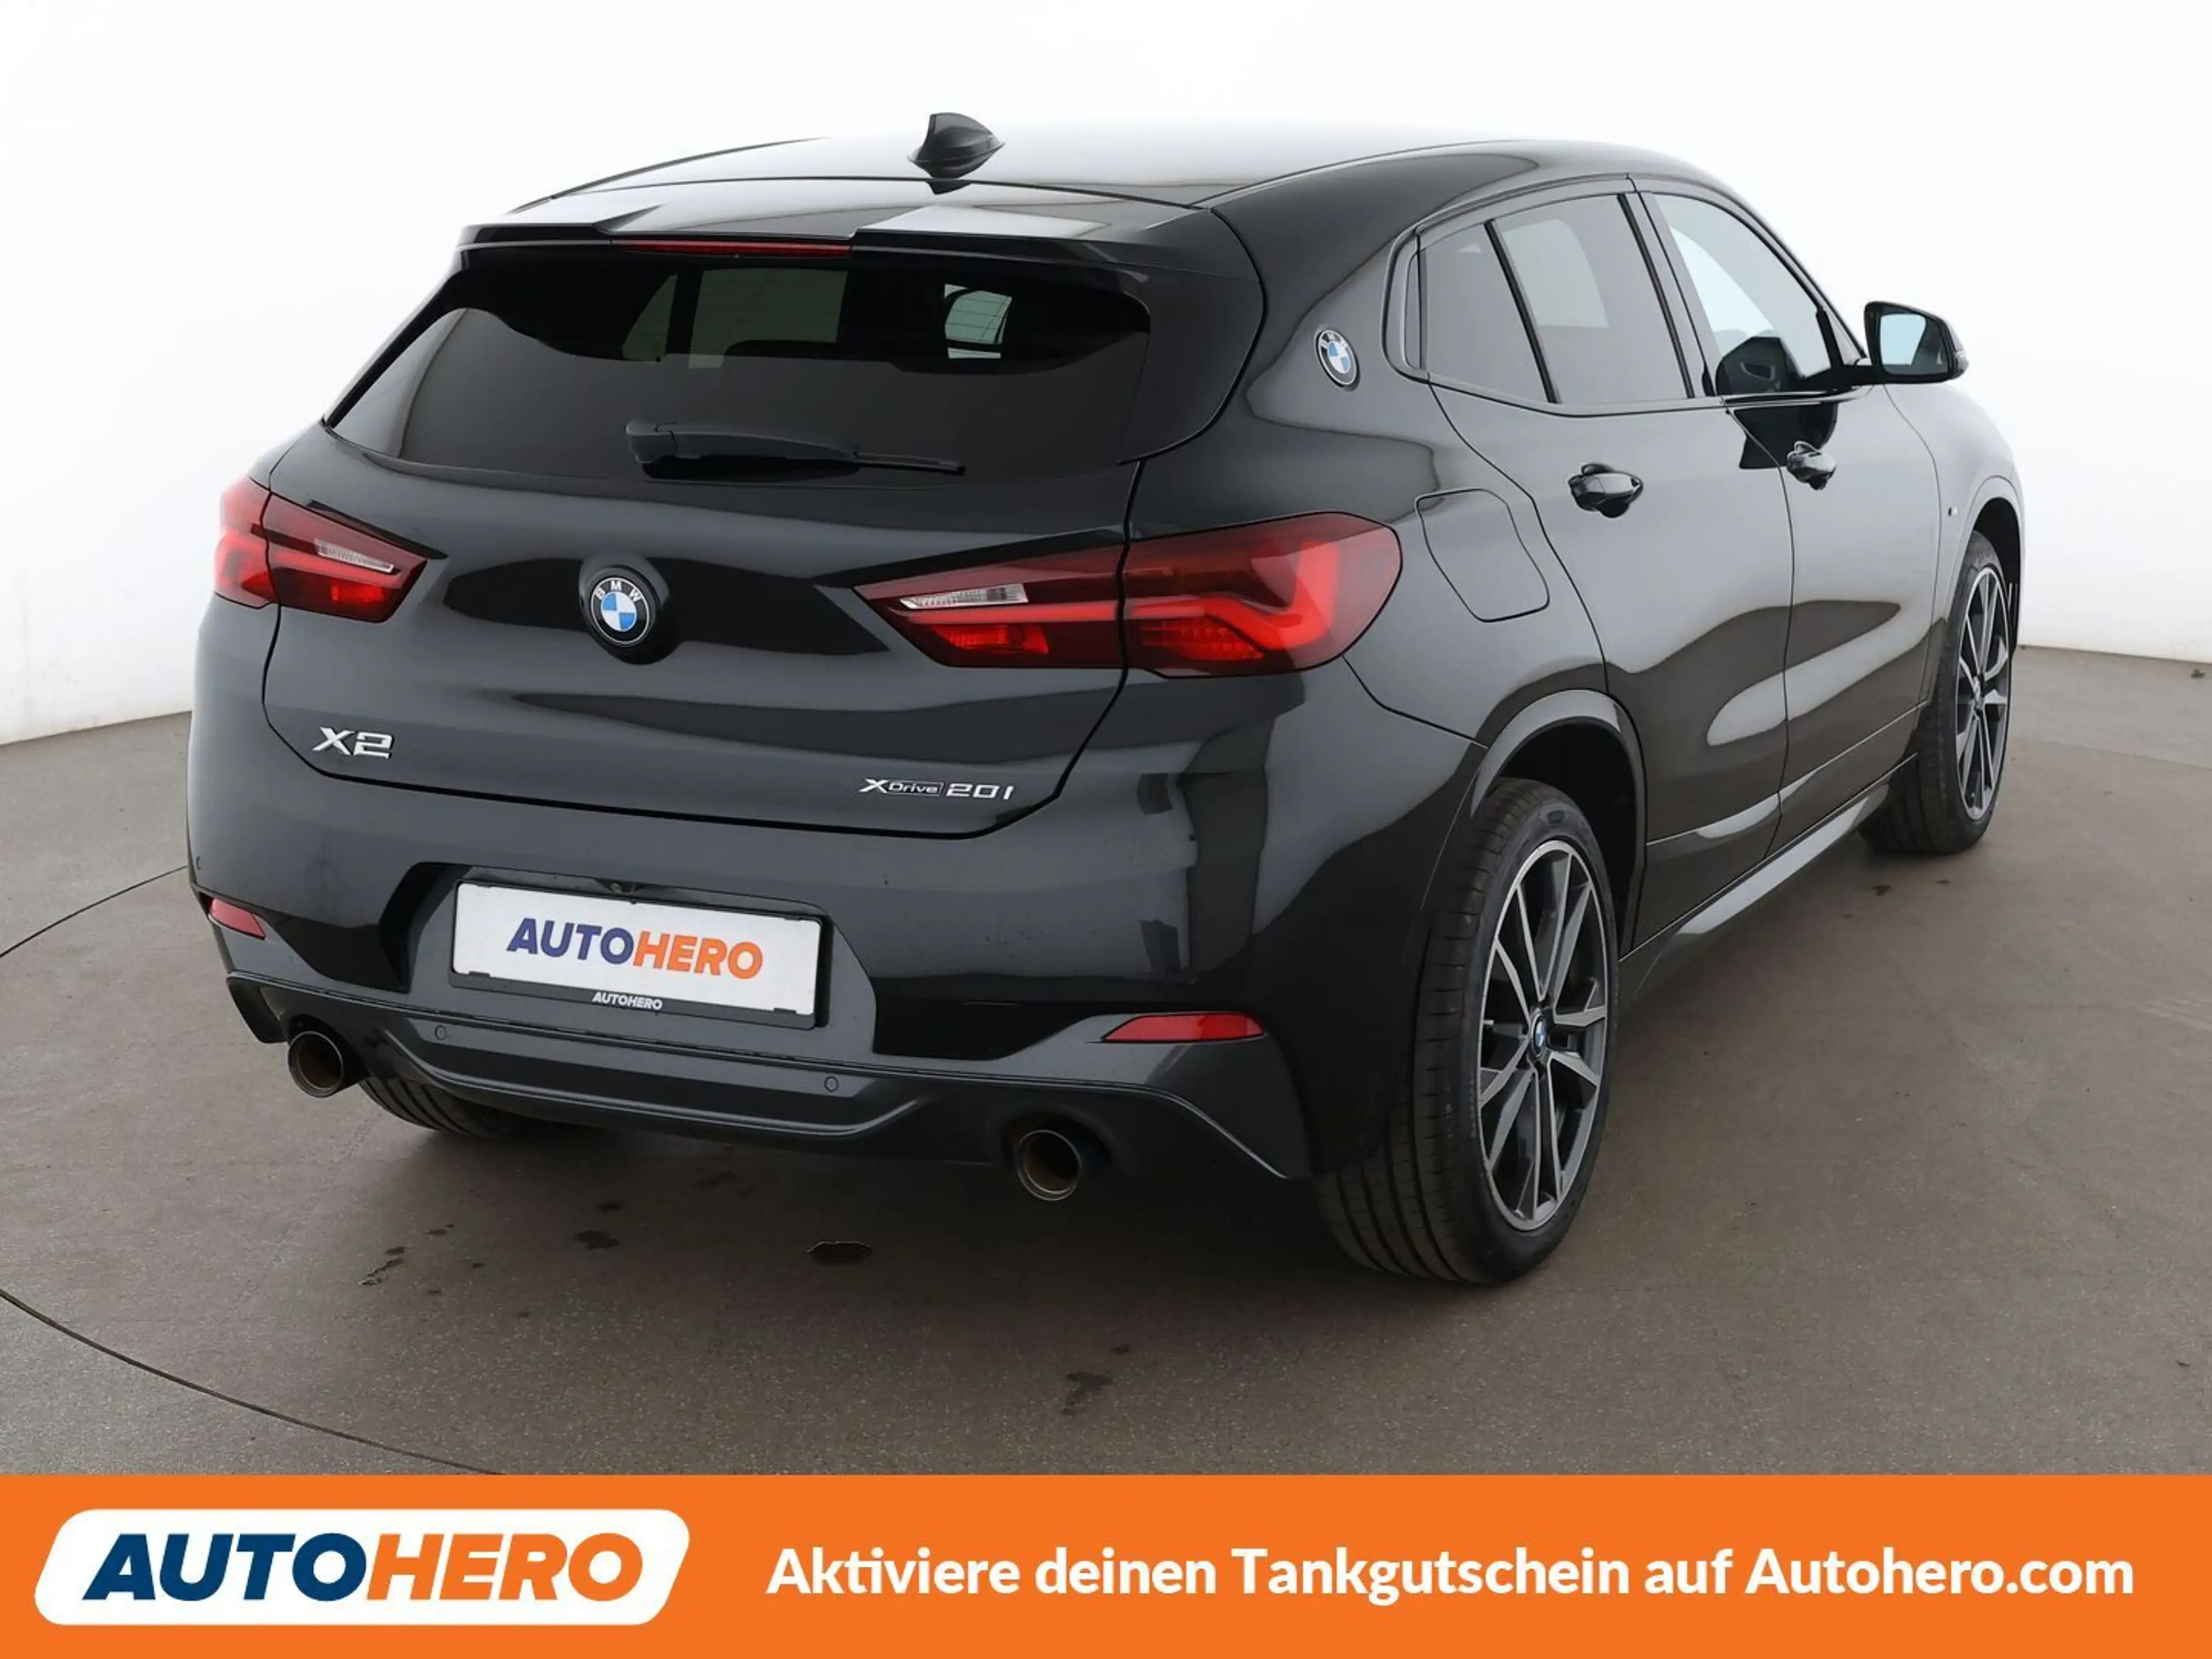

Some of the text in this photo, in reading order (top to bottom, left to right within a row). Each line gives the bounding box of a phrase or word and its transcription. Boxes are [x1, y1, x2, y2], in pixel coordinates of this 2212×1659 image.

[595, 581, 642, 602] BMW
[312, 726, 393, 759] X2
[506, 918, 763, 980] AUTOHERO
[592, 991, 663, 1010] AUTOHERO
